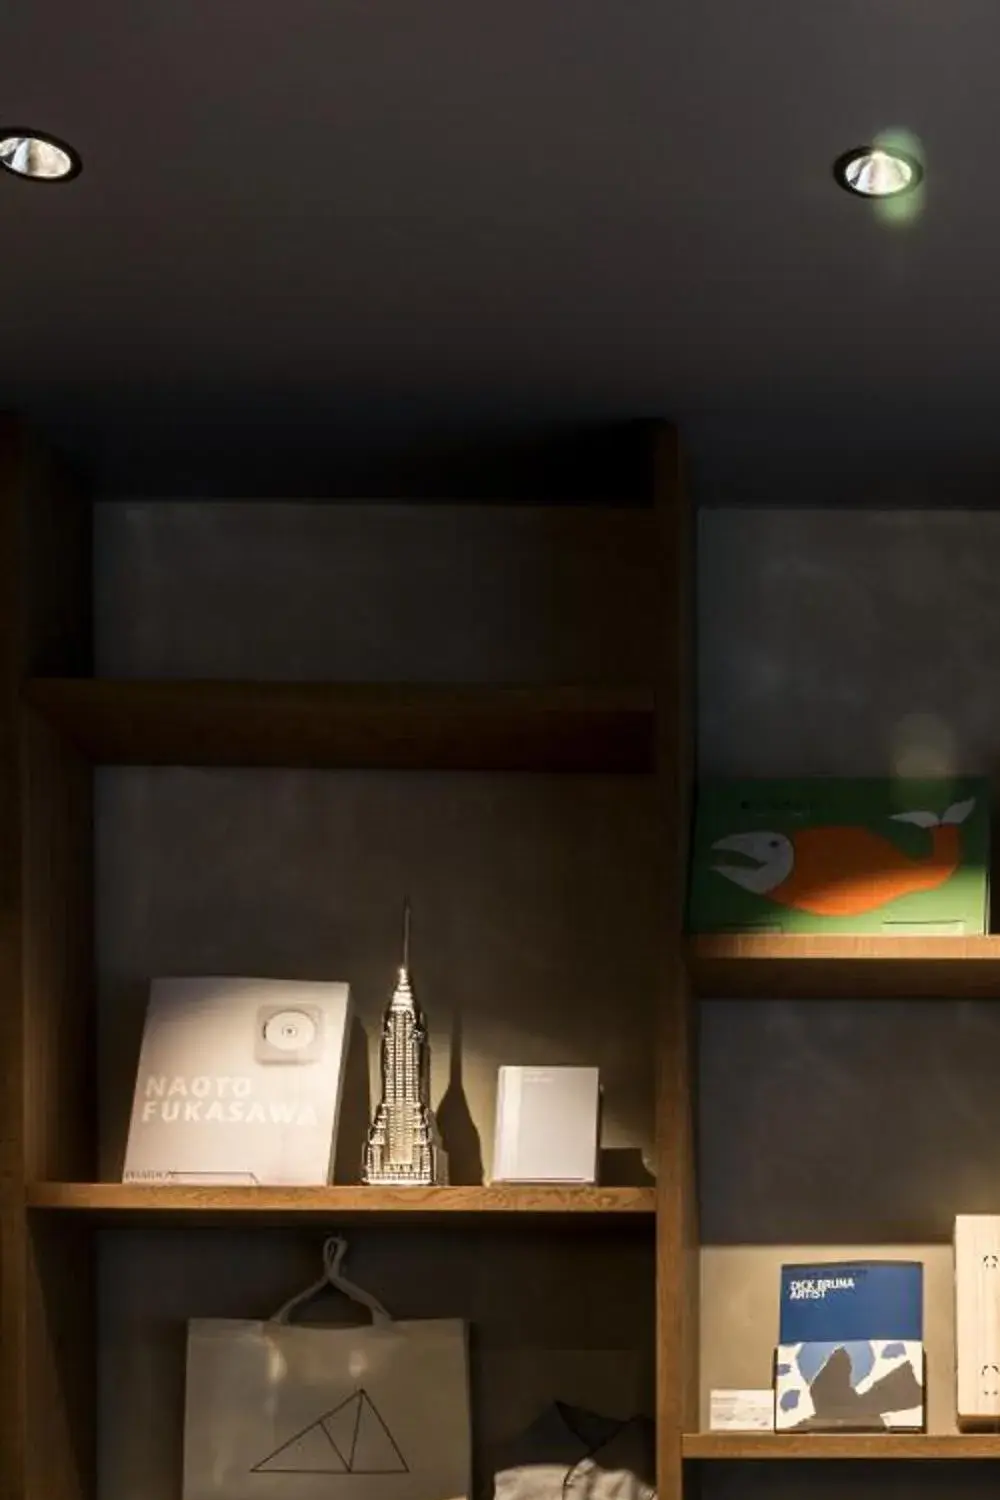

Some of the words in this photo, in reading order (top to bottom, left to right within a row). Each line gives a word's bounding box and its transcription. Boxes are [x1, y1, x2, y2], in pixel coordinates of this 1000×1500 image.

[144, 1076, 252, 1098] NAOTO
[141, 1100, 318, 1126] FUKASAWA
[790, 1279, 814, 1291] DICK
[817, 1277, 855, 1290] BRUNA
[789, 1289, 826, 1300] ARTIST
